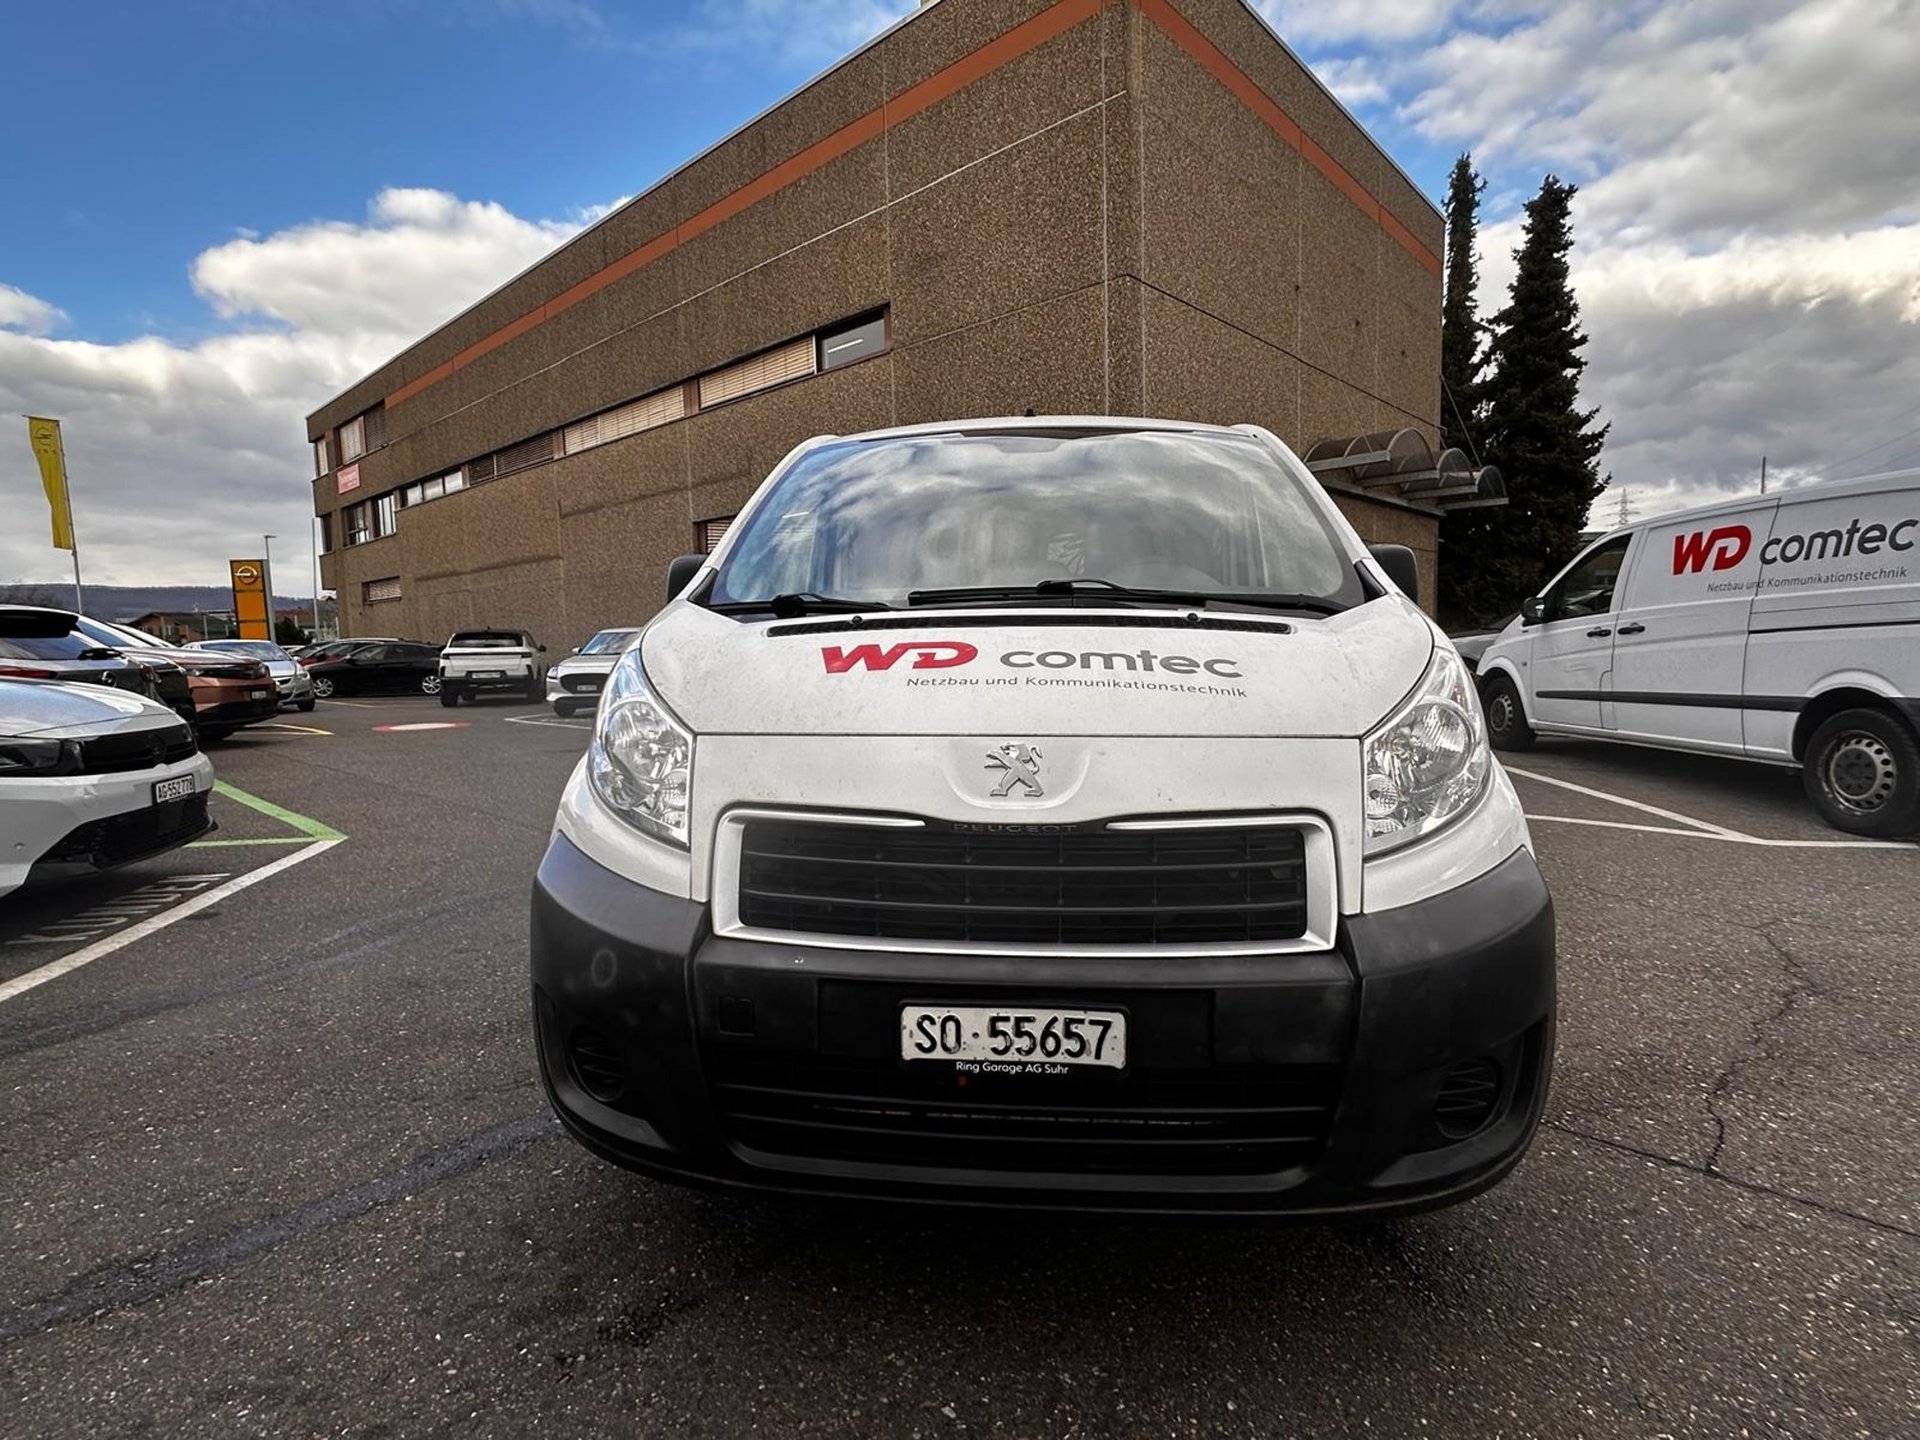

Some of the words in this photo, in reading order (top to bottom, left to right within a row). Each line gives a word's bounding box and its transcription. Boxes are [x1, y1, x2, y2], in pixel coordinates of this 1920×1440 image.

[1672, 525, 1752, 576] WD
[1759, 518, 1919, 566] comtec
[1706, 579, 1744, 593] Netzbau
[1745, 579, 1765, 591] und
[1767, 566, 1909, 588] Kommunikationstechnik
[821, 641, 979, 674] WD
[999, 649, 1244, 679] comtec
[906, 675, 979, 688] Netzbau
[985, 676, 1018, 687] und
[1025, 676, 1248, 698] Kommunikationstechnik
[952, 823, 1077, 833] PEUGEOT
[956, 1061, 980, 1074] Ring
[981, 1062, 1023, 1075] Garage
[1025, 1063, 1042, 1074] AG
[1044, 1064, 1069, 1075] Suhr
